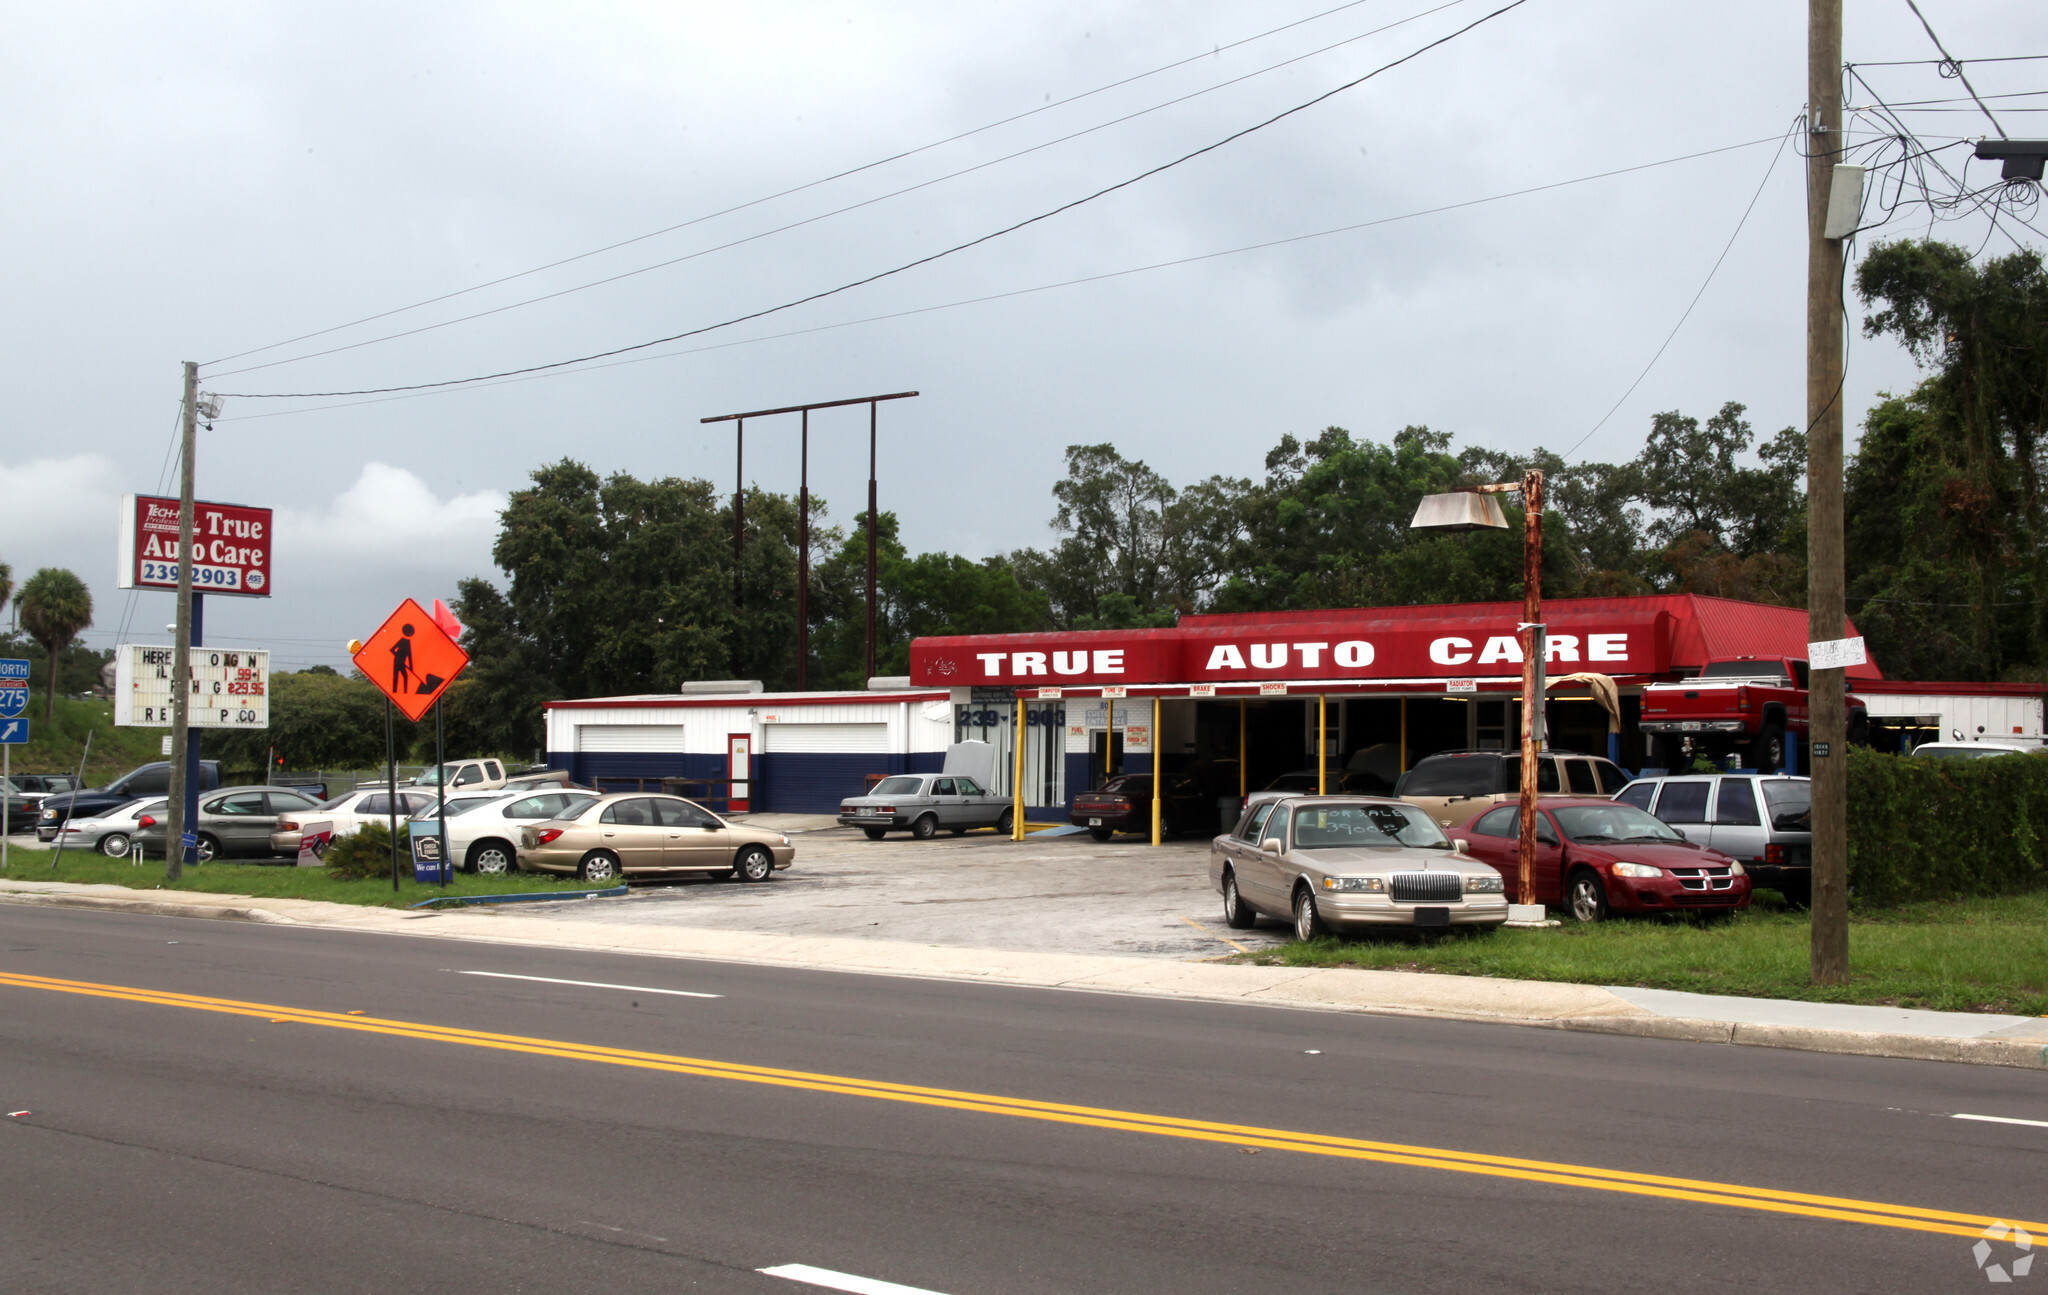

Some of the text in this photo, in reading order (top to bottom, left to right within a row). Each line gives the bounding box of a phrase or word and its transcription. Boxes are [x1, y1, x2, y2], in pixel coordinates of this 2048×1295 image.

[206, 511, 263, 539] True
[143, 533, 264, 567] Auo Care
[143, 650, 171, 665] HERE
[1205, 640, 1375, 670] AUTO
[1429, 633, 1629, 666] CARE
[976, 649, 1125, 677] TRUE
[228, 682, 265, 695] $29.95
[1262, 683, 1286, 691] SHOCKS
[0, 690, 26, 708] 275
[1318, 808, 1402, 818] FOR SALE
